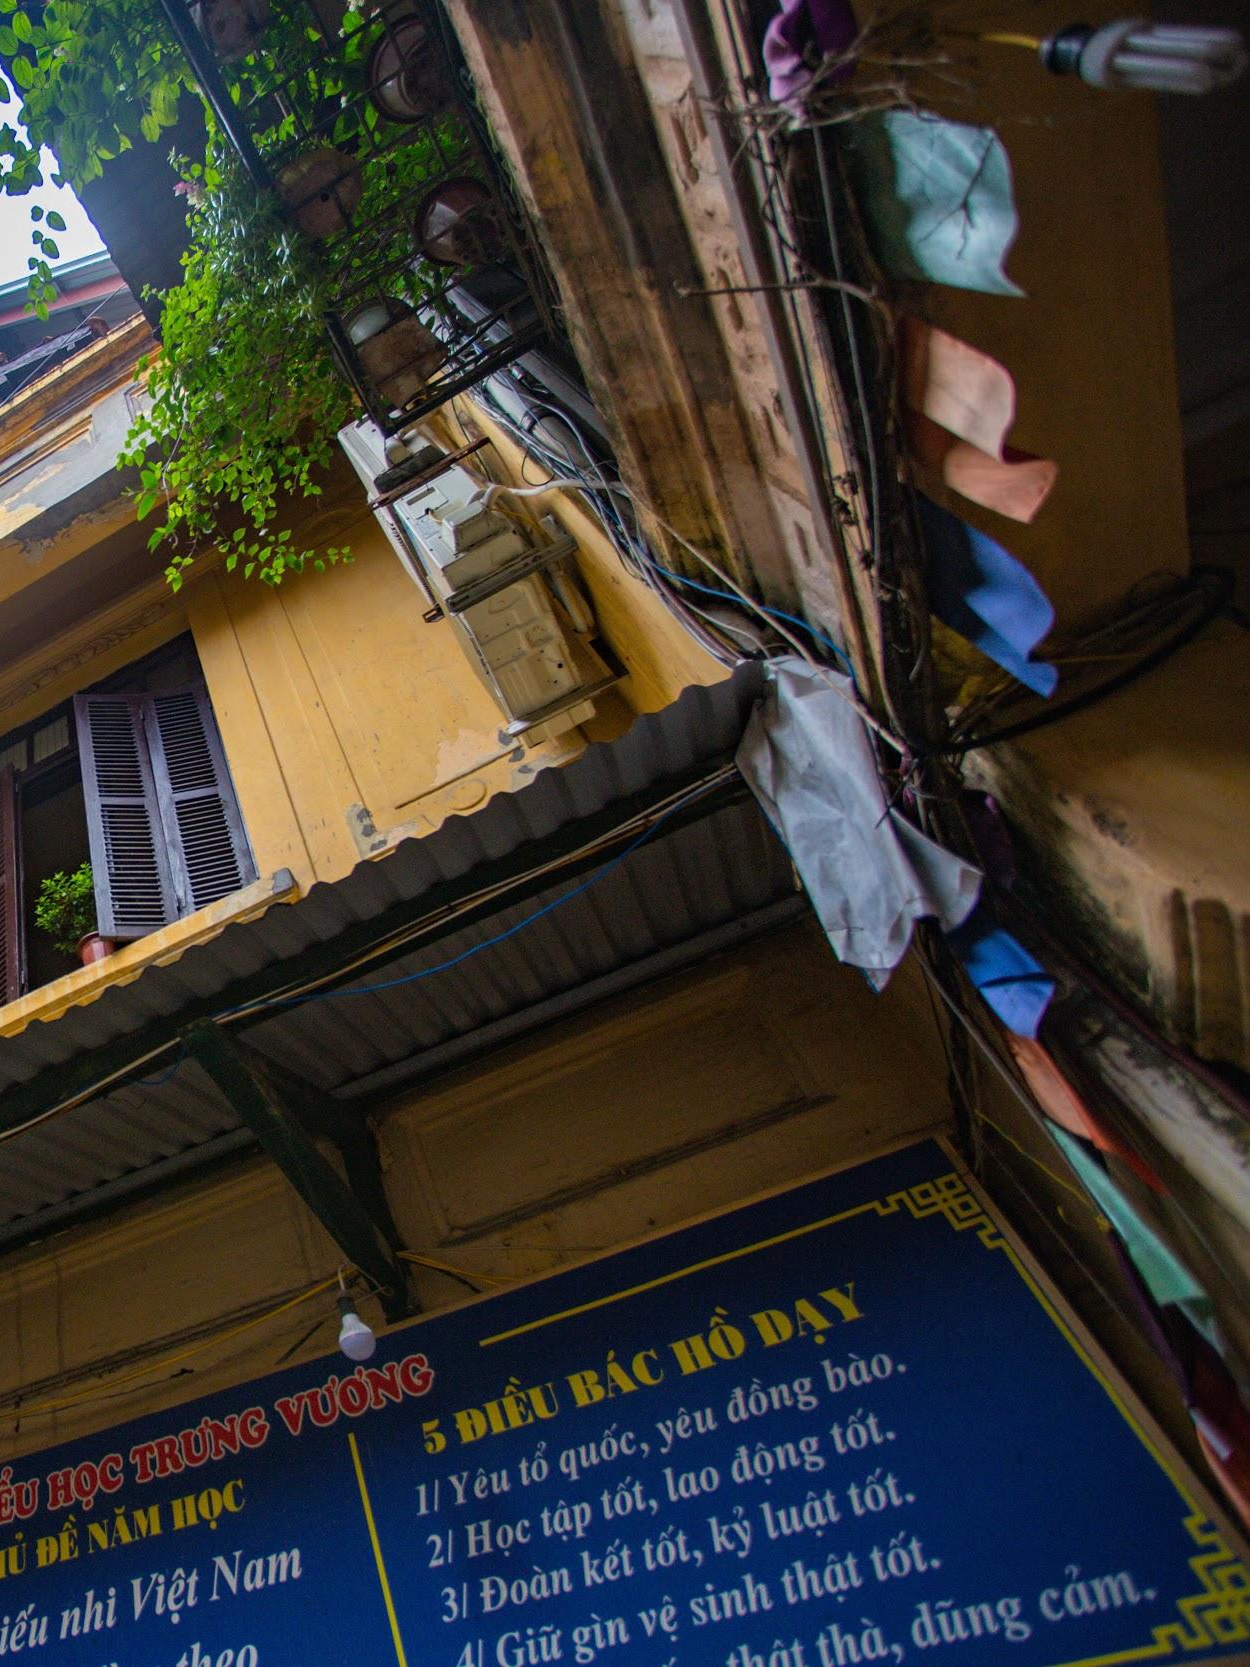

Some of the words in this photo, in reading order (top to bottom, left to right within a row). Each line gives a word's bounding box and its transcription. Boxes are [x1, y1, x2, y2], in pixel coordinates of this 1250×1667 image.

[46, 1453, 123, 1511] HỌC
[130, 1407, 270, 1484] TRƯNG
[274, 1354, 434, 1436] VƯƠNG
[415, 1479, 439, 1516] 1/
[448, 1467, 510, 1504] Yêu
[518, 1441, 549, 1486] tổ
[559, 1422, 650, 1481] quốc,
[655, 1407, 718, 1454] yêu
[726, 1377, 819, 1424] đồng
[821, 1353, 907, 1393] bào.
[421, 1418, 447, 1454] 5
[454, 1376, 560, 1444] ĐIỀU
[566, 1349, 664, 1408] BÁC
[668, 1305, 746, 1376] HỒ
[749, 1281, 865, 1348] DẠY
[36, 1514, 79, 1568] ĐỀ
[87, 1504, 162, 1553] NĂM
[170, 1479, 245, 1530] HỌC
[426, 1529, 452, 1568] 2/
[465, 1519, 531, 1557] Học
[540, 1499, 592, 1541] tập
[600, 1476, 659, 1520] tốt,
[662, 1466, 720, 1502] lao
[731, 1436, 825, 1485] động
[830, 1408, 896, 1454] tốt.
[441, 1582, 467, 1623] 3/
[479, 1565, 573, 1613] Đoàn
[580, 1538, 634, 1587] kết
[641, 1524, 703, 1571] tốt,
[707, 1505, 751, 1558] kỷ
[759, 1490, 841, 1539] luật
[848, 1467, 916, 1517] tốt.
[60, 1587, 117, 1639] nhi
[130, 1566, 199, 1624] Việt
[208, 1548, 303, 1600] Nam
[496, 1624, 563, 1667] Giữ
[572, 1613, 630, 1664] gìn
[637, 1595, 678, 1642] vệ
[689, 1574, 773, 1626] sinh
[781, 1552, 863, 1602] thật
[870, 1530, 941, 1582] tốt.
[815, 1616, 905, 1665] thà,
[911, 1597, 1033, 1649] dũng
[1038, 1564, 1158, 1622] cảm.
